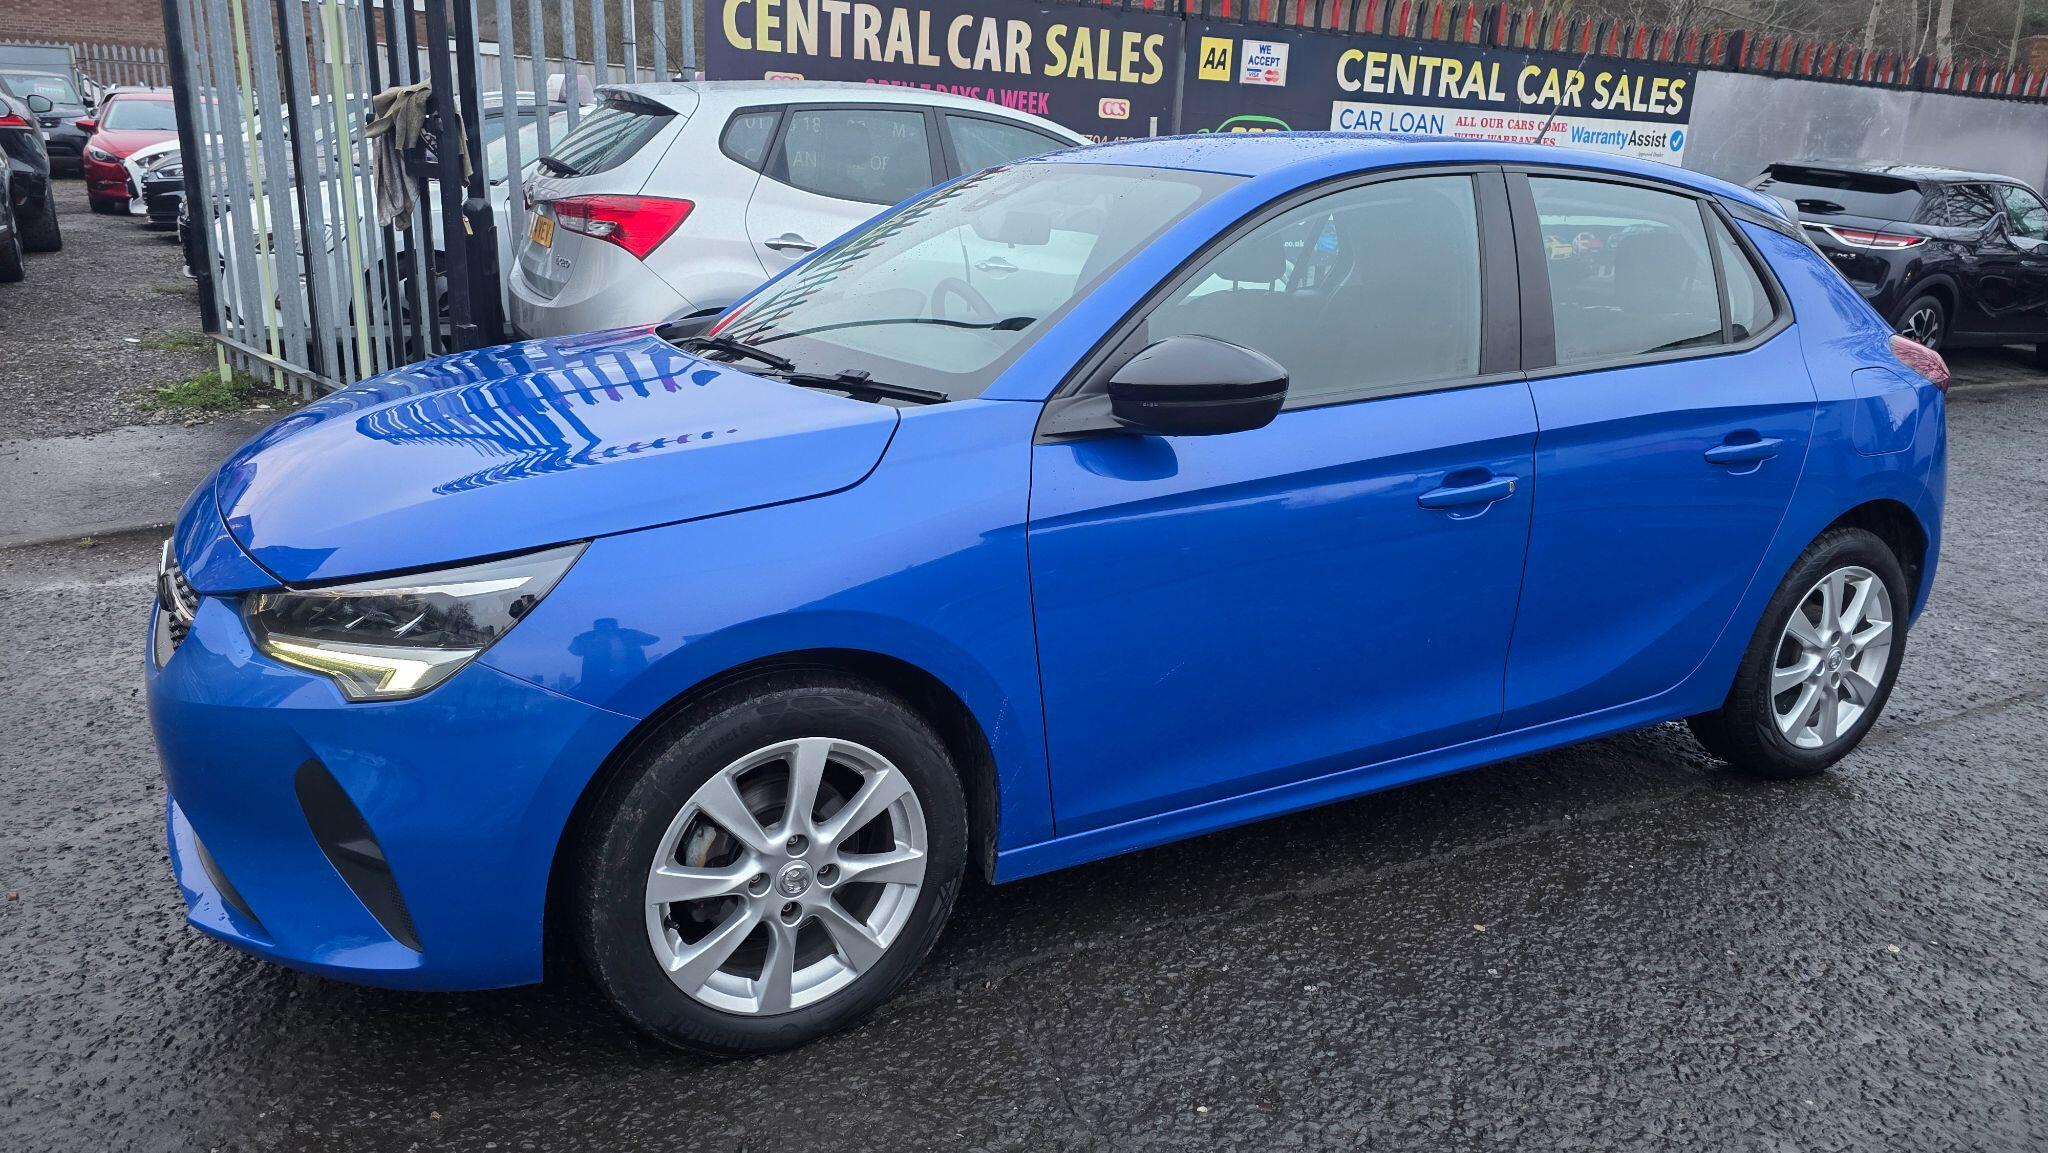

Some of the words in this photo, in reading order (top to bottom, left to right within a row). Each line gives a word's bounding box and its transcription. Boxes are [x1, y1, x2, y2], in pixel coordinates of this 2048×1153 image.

[722, 0, 941, 67] CENTRAL
[947, 14, 1033, 75] CAR
[1043, 24, 1165, 85] SALES
[1259, 44, 1272, 54] WE
[1203, 47, 1228, 70] AA
[1247, 55, 1280, 67] ACCEPT
[1336, 49, 1506, 102] CENTRAL
[1516, 65, 1586, 108] CAR
[1590, 71, 1687, 116] SALES
[1001, 89, 1050, 115] WEEK
[1339, 108, 1383, 132] CAR
[1389, 111, 1445, 135] LOAN
[1455, 116, 1477, 127] ALL
[1480, 117, 1504, 129] OUR
[1507, 119, 1535, 131] CARS
